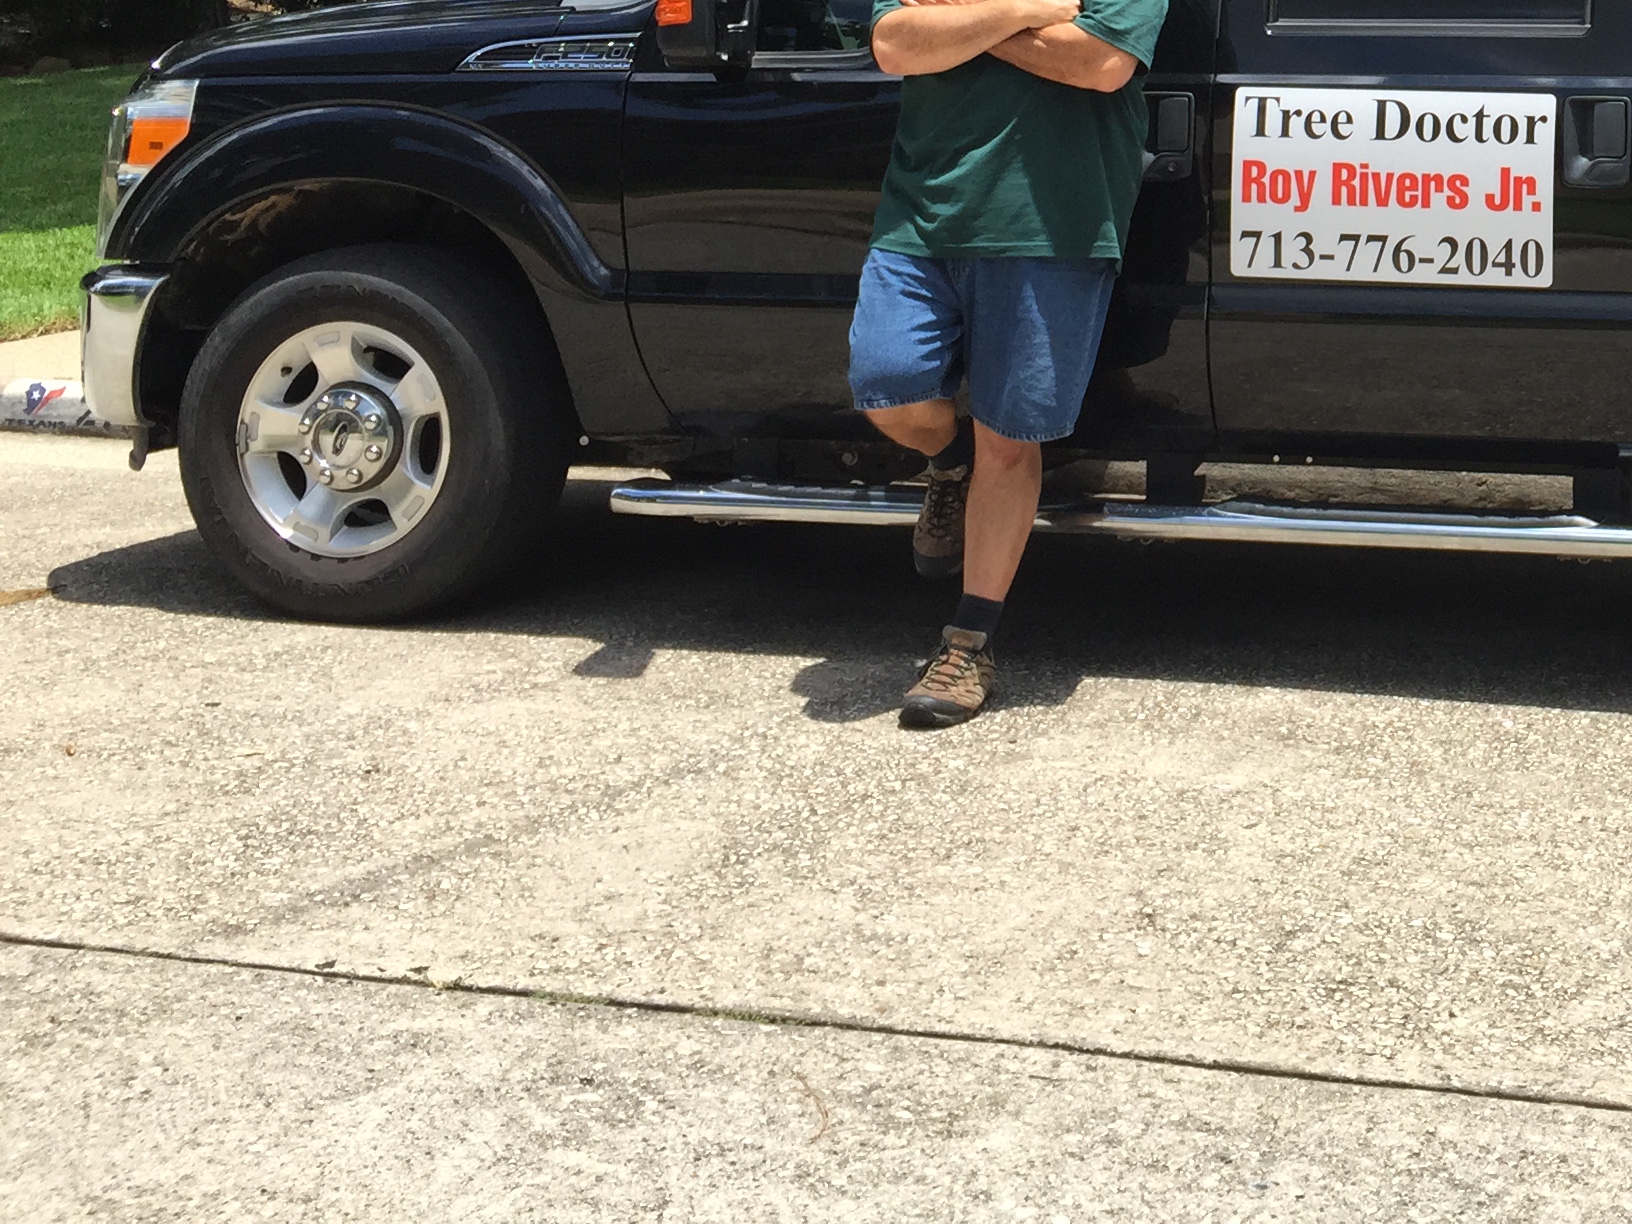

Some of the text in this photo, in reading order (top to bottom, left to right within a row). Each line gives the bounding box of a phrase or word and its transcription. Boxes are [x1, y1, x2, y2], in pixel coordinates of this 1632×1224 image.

[1244, 96, 1548, 145] Tree Doctor
[1241, 159, 1542, 213] Roy Rivers Jr.
[1238, 230, 1545, 279] 713-776-2040
[4, 418, 67, 430] TEXANS
